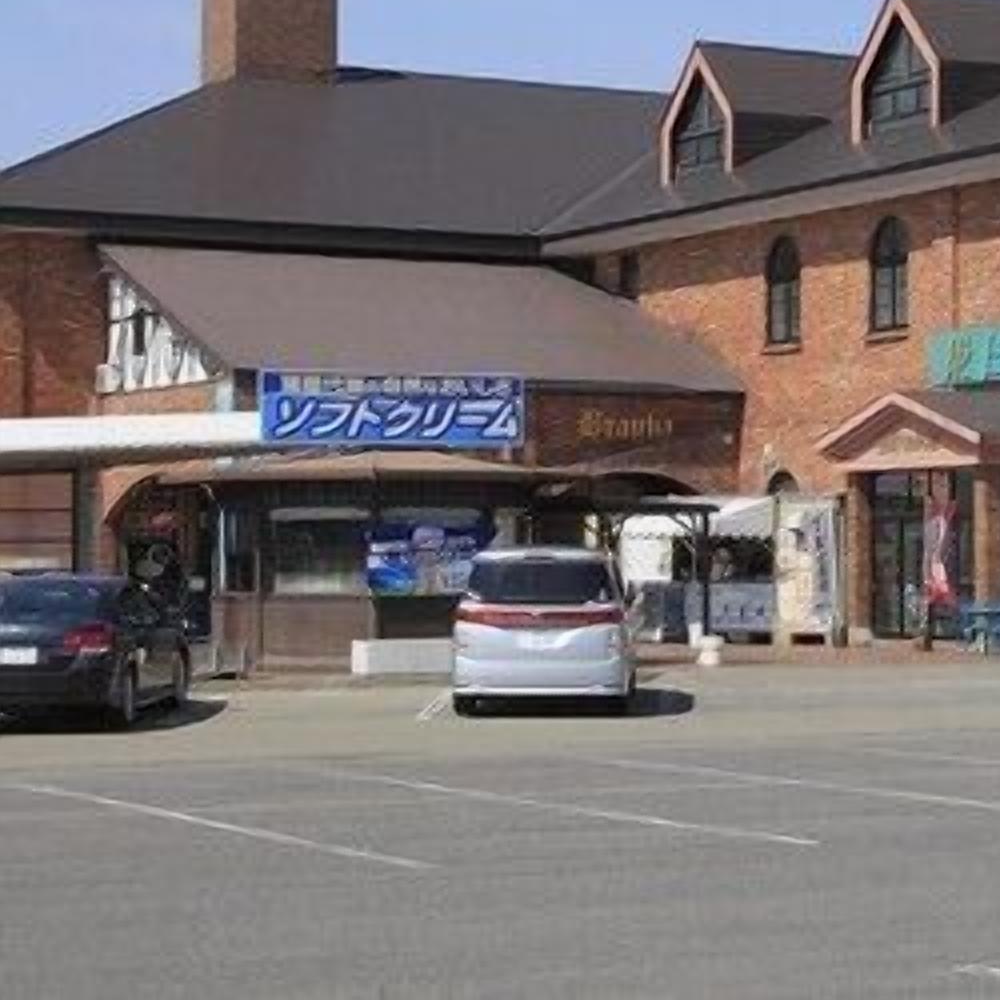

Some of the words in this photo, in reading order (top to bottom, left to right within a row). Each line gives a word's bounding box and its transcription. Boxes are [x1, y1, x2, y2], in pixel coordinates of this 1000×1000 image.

[274, 398, 517, 438] ソフトクリーム
